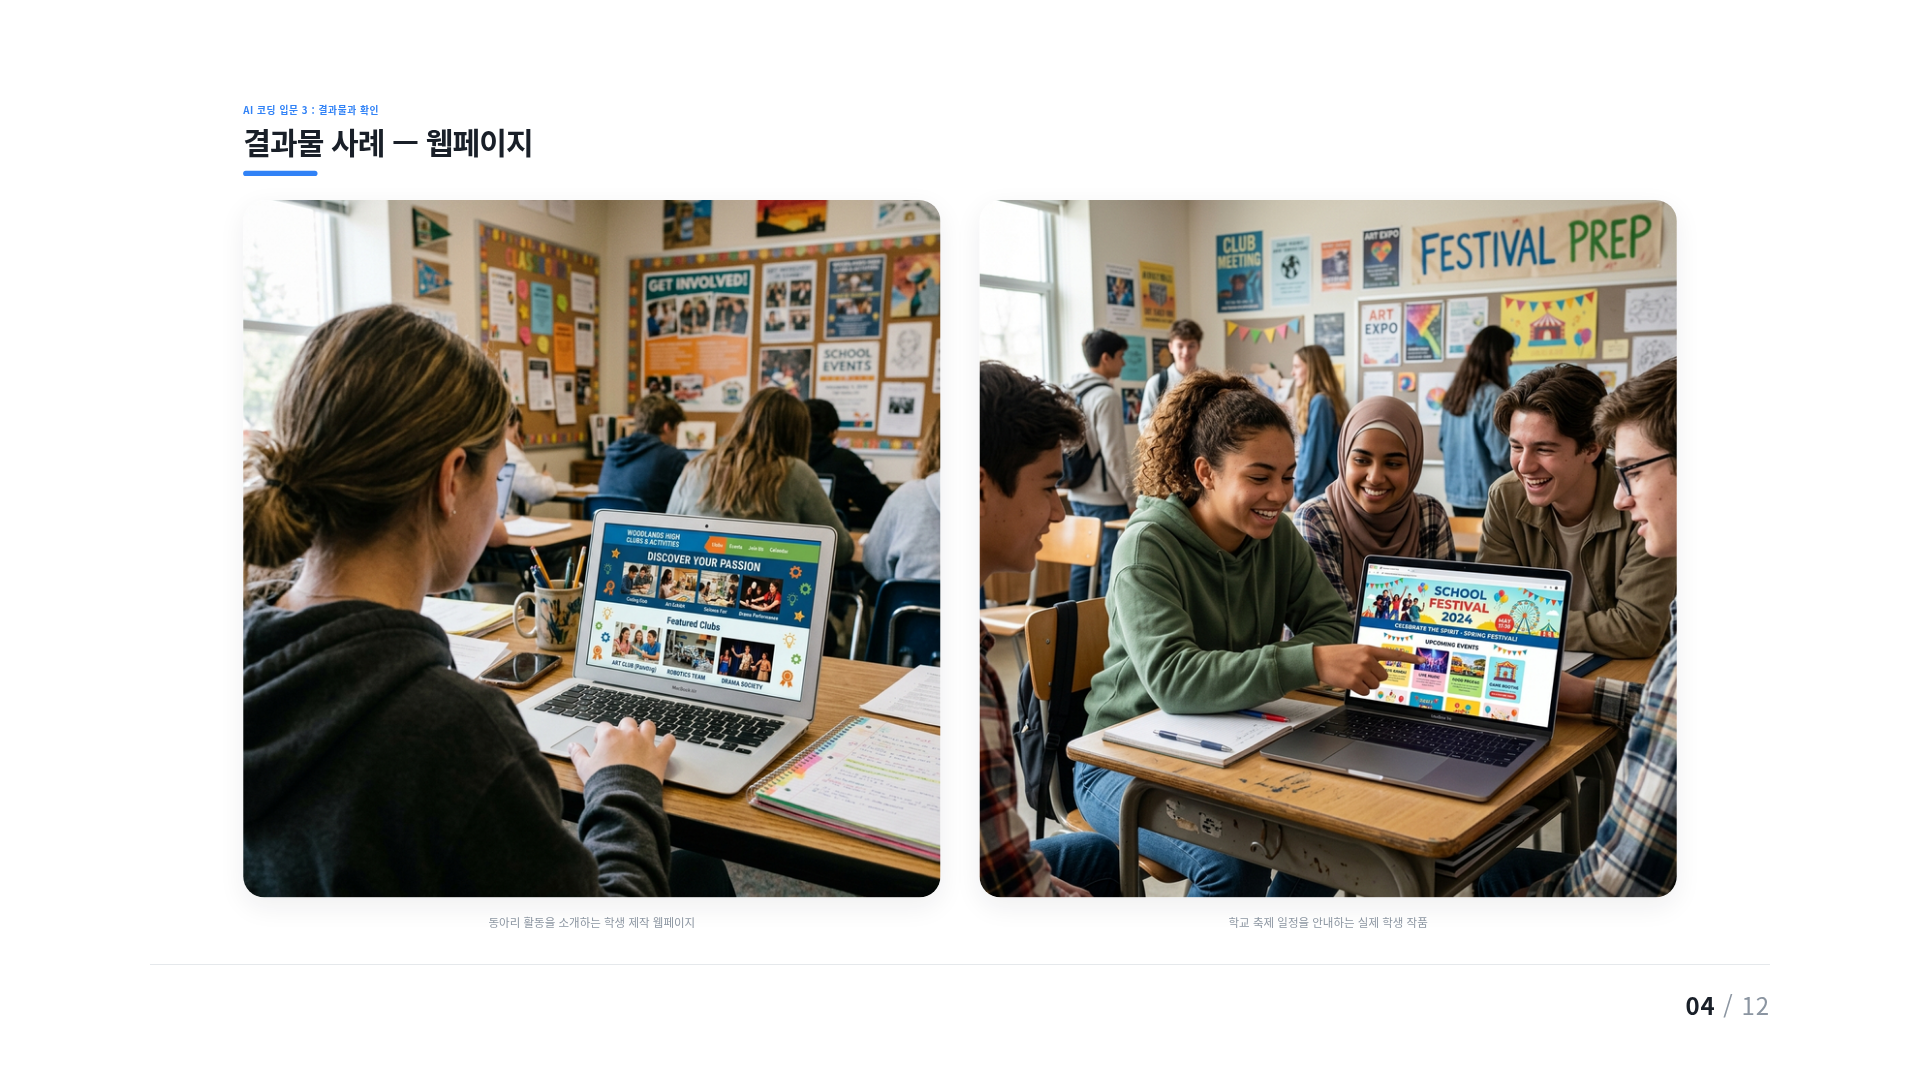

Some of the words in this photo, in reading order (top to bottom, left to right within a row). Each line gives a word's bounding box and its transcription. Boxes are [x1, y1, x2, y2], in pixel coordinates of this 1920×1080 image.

[1364, 231, 1378, 241] ART
[1379, 229, 1399, 240] EXPO
[1223, 234, 1256, 254] CLUB
[1420, 225, 1556, 276] FESTIVAL
[1568, 214, 1652, 263] PREP
[1217, 252, 1261, 269] MEETING
[648, 277, 673, 292] GET
[676, 272, 748, 291] INVOLVED!
[1369, 308, 1394, 321] ART
[1365, 322, 1398, 335] EXPO
[823, 347, 872, 359] SCHOOL
[823, 360, 872, 371] EVENTS
[627, 529, 664, 539] WOODLANDS
[649, 539, 680, 548] ACTIVITIES
[647, 551, 691, 565] DISCOVER
[694, 556, 718, 568] YOUR
[719, 558, 761, 572] PASSION
[1434, 586, 1488, 601] SCHOOL
[1429, 598, 1490, 614] FESTIVAL
[666, 616, 698, 628] Featured
[699, 620, 721, 631] Clubs
[1441, 611, 1473, 625] 2024
[1394, 622, 1427, 632] CELEBRATE
[1440, 627, 1459, 635] SPIRIT
[1464, 630, 1486, 639] SPRING
[1487, 633, 1518, 642] FESTIVAL!
[1425, 639, 1456, 648] UPCOMING
[1457, 643, 1479, 651] EVENTS
[622, 661, 634, 669] CLUB
[667, 668, 691, 678] ROBOTICS
[691, 672, 706, 681] TEAM
[721, 677, 740, 687] DRAMA
[740, 681, 763, 690] SOCIETY
